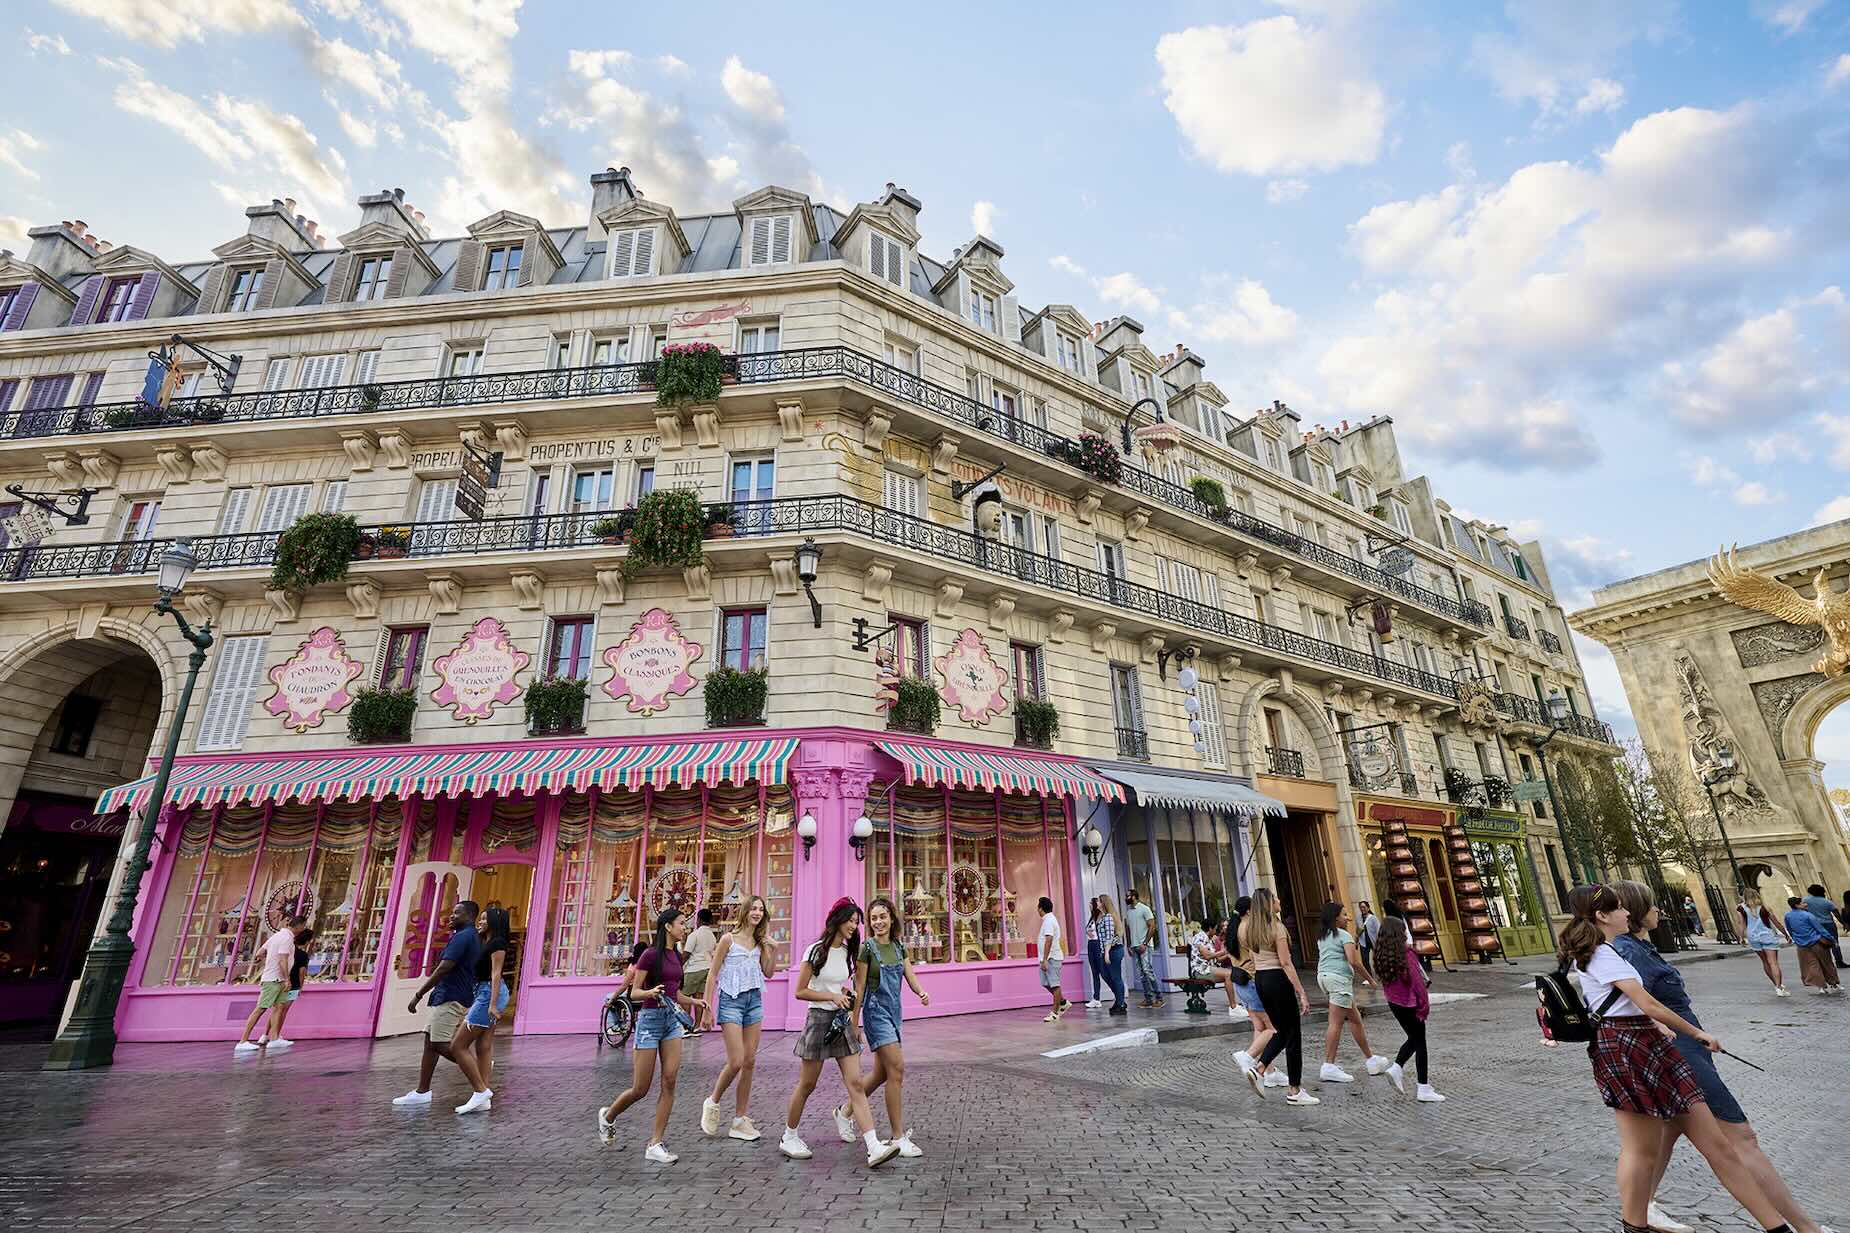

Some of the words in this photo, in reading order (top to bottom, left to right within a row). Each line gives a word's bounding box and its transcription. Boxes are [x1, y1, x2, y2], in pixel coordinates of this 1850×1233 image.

[530, 439, 616, 459] PROPENTUS
[624, 439, 633, 453] &
[629, 646, 677, 660] BONBONS
[290, 663, 342, 679] FONDANTS
[623, 665, 681, 679] CLASSIQUES
[287, 681, 338, 695] CHAUDRON
